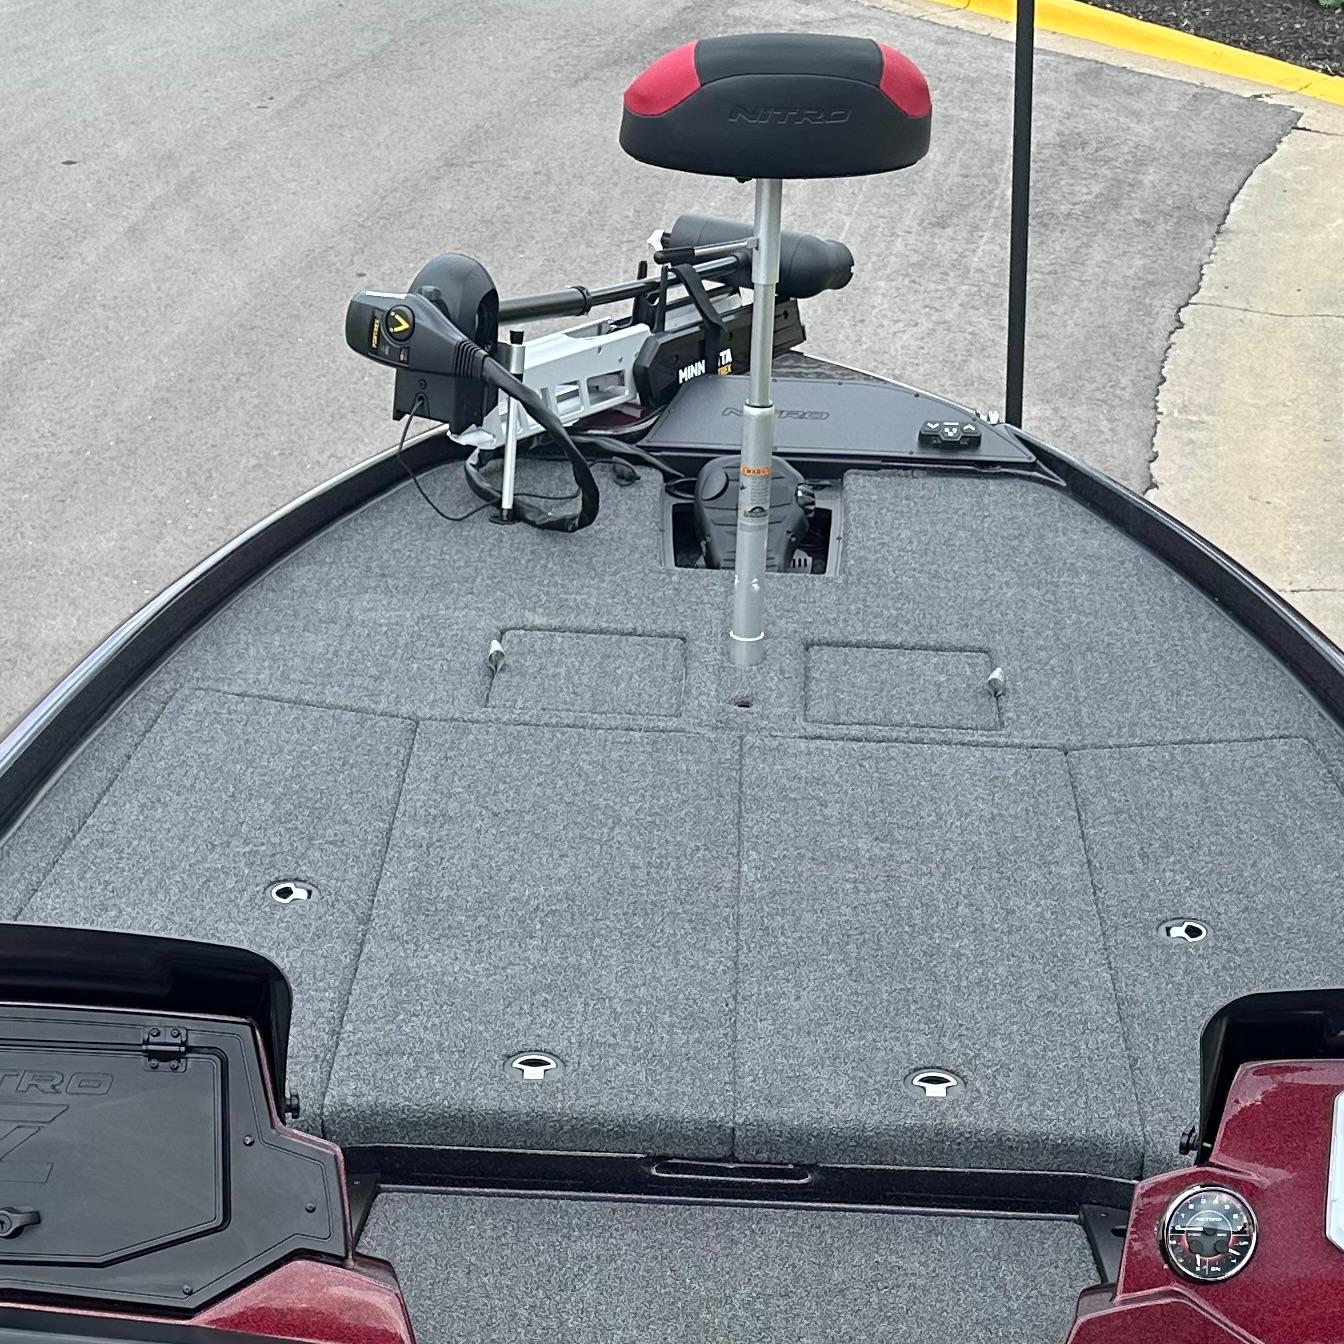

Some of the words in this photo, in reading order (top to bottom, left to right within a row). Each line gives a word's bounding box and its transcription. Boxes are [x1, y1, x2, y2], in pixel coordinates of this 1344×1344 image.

[726, 105, 852, 125] NITRO
[678, 359, 706, 384] MINN
[721, 406, 831, 422] NRO
